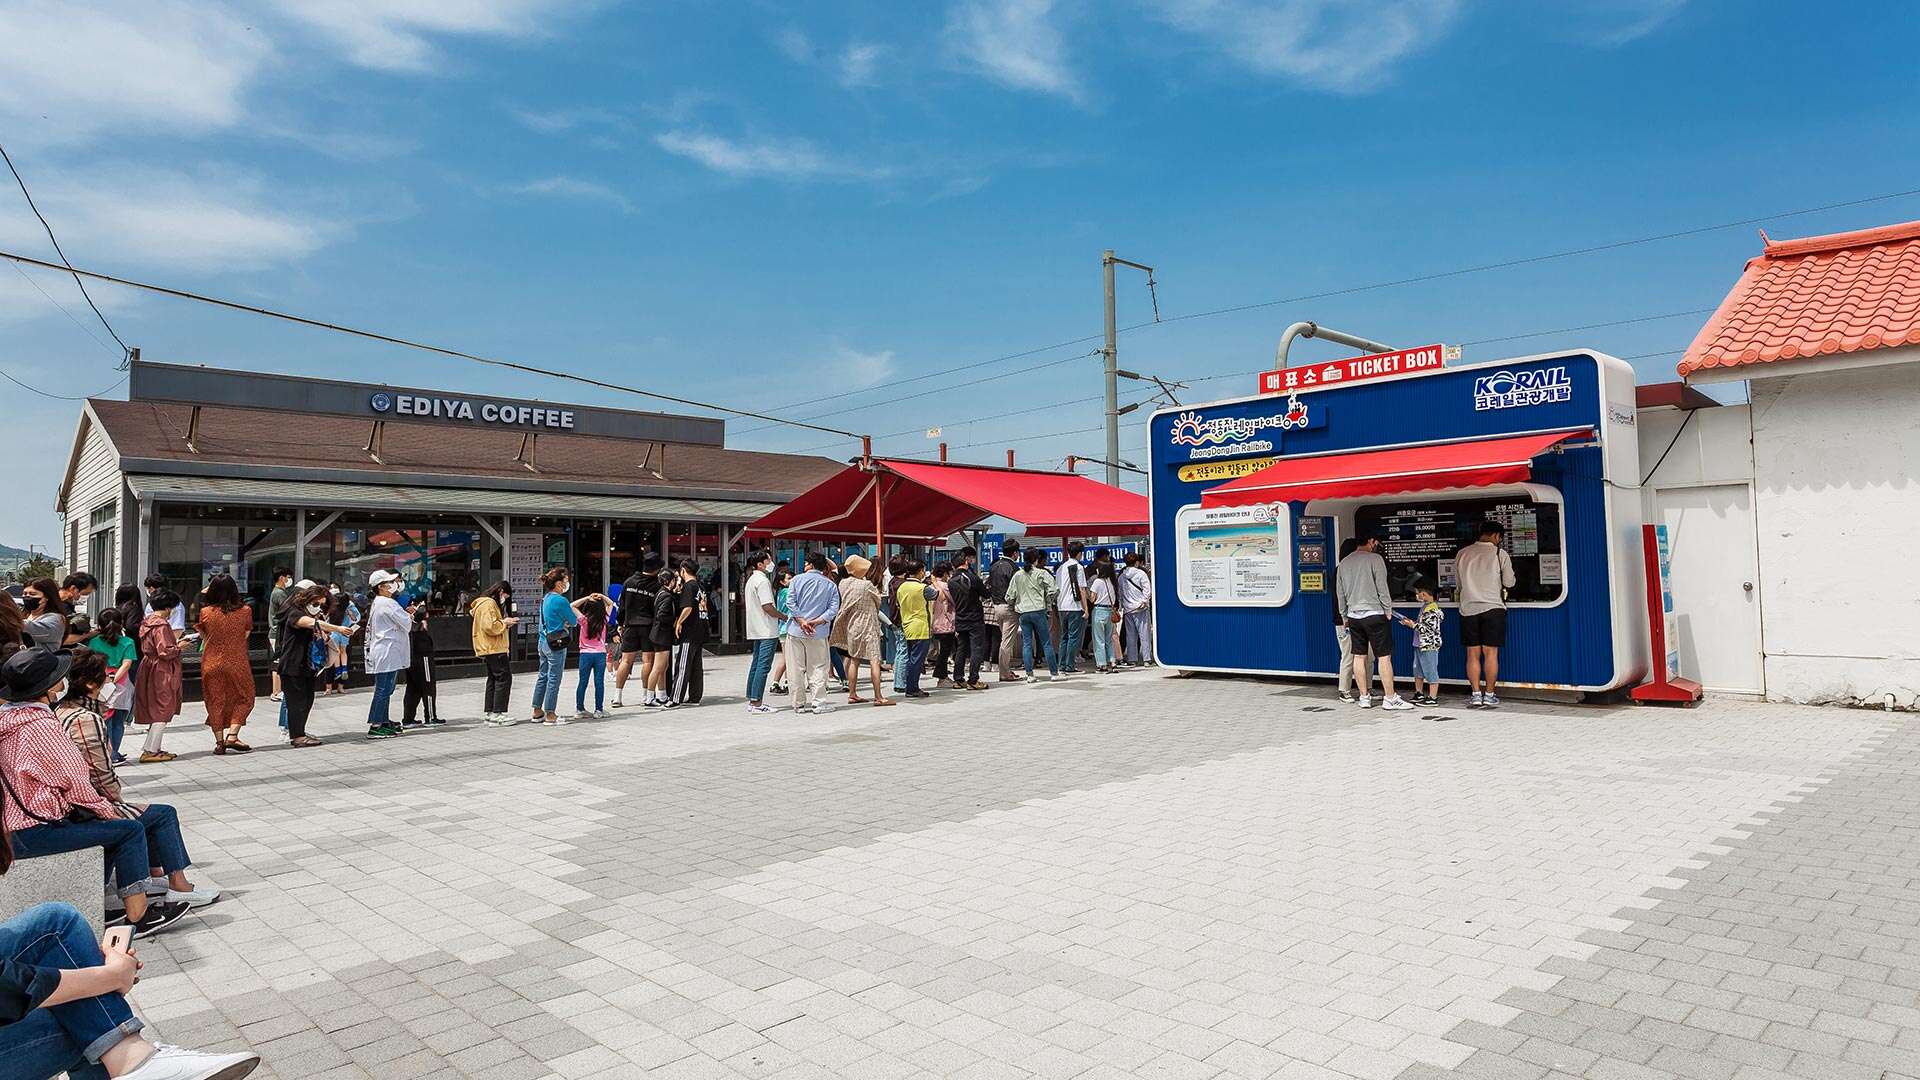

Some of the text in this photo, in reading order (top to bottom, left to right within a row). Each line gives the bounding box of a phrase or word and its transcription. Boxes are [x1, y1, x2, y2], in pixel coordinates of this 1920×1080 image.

[1349, 355, 1400, 377] TICKET
[1405, 349, 1438, 369] BOX
[1475, 367, 1570, 396] KORAIL
[1476, 387, 1570, 410] 코레일관광개발
[396, 395, 474, 420] EDIYA
[481, 404, 574, 429] COFFEE
[1207, 416, 1283, 437] 정동진레일바이크
[1190, 441, 1272, 458] JeongDongJin Railbike
